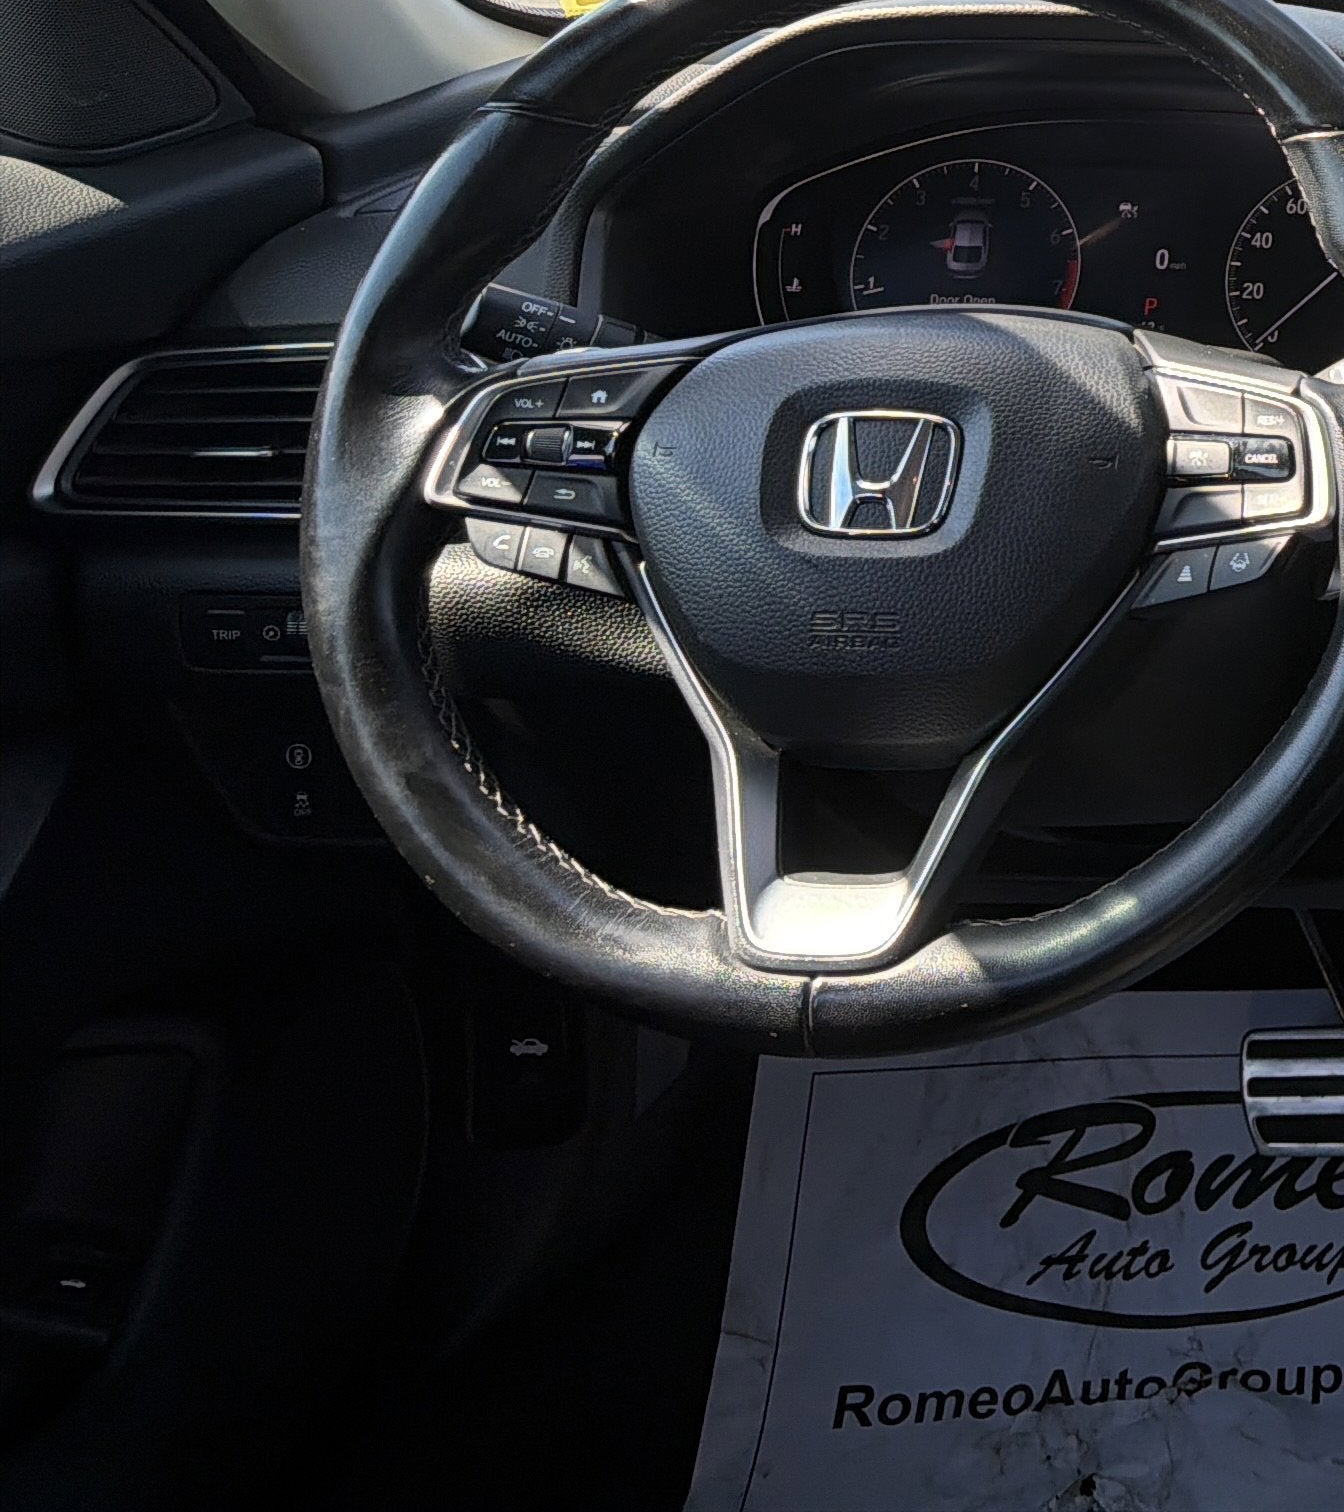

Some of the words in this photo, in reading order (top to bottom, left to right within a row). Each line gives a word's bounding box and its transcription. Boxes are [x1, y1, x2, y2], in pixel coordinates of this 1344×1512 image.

[1285, 198, 1307, 215] 60
[791, 224, 802, 236] H
[1251, 232, 1273, 249] 40
[1155, 249, 1169, 270] 0
[930, 294, 960, 304] Door
[1242, 283, 1264, 299] 20
[521, 301, 548, 316] OFF
[1144, 298, 1158, 315] P
[495, 329, 533, 348] AUTO
[1244, 453, 1279, 464] CANCEL
[811, 610, 900, 631] SRS
[211, 629, 241, 640] TRIP
[1025, 1230, 1176, 1287] Auto
